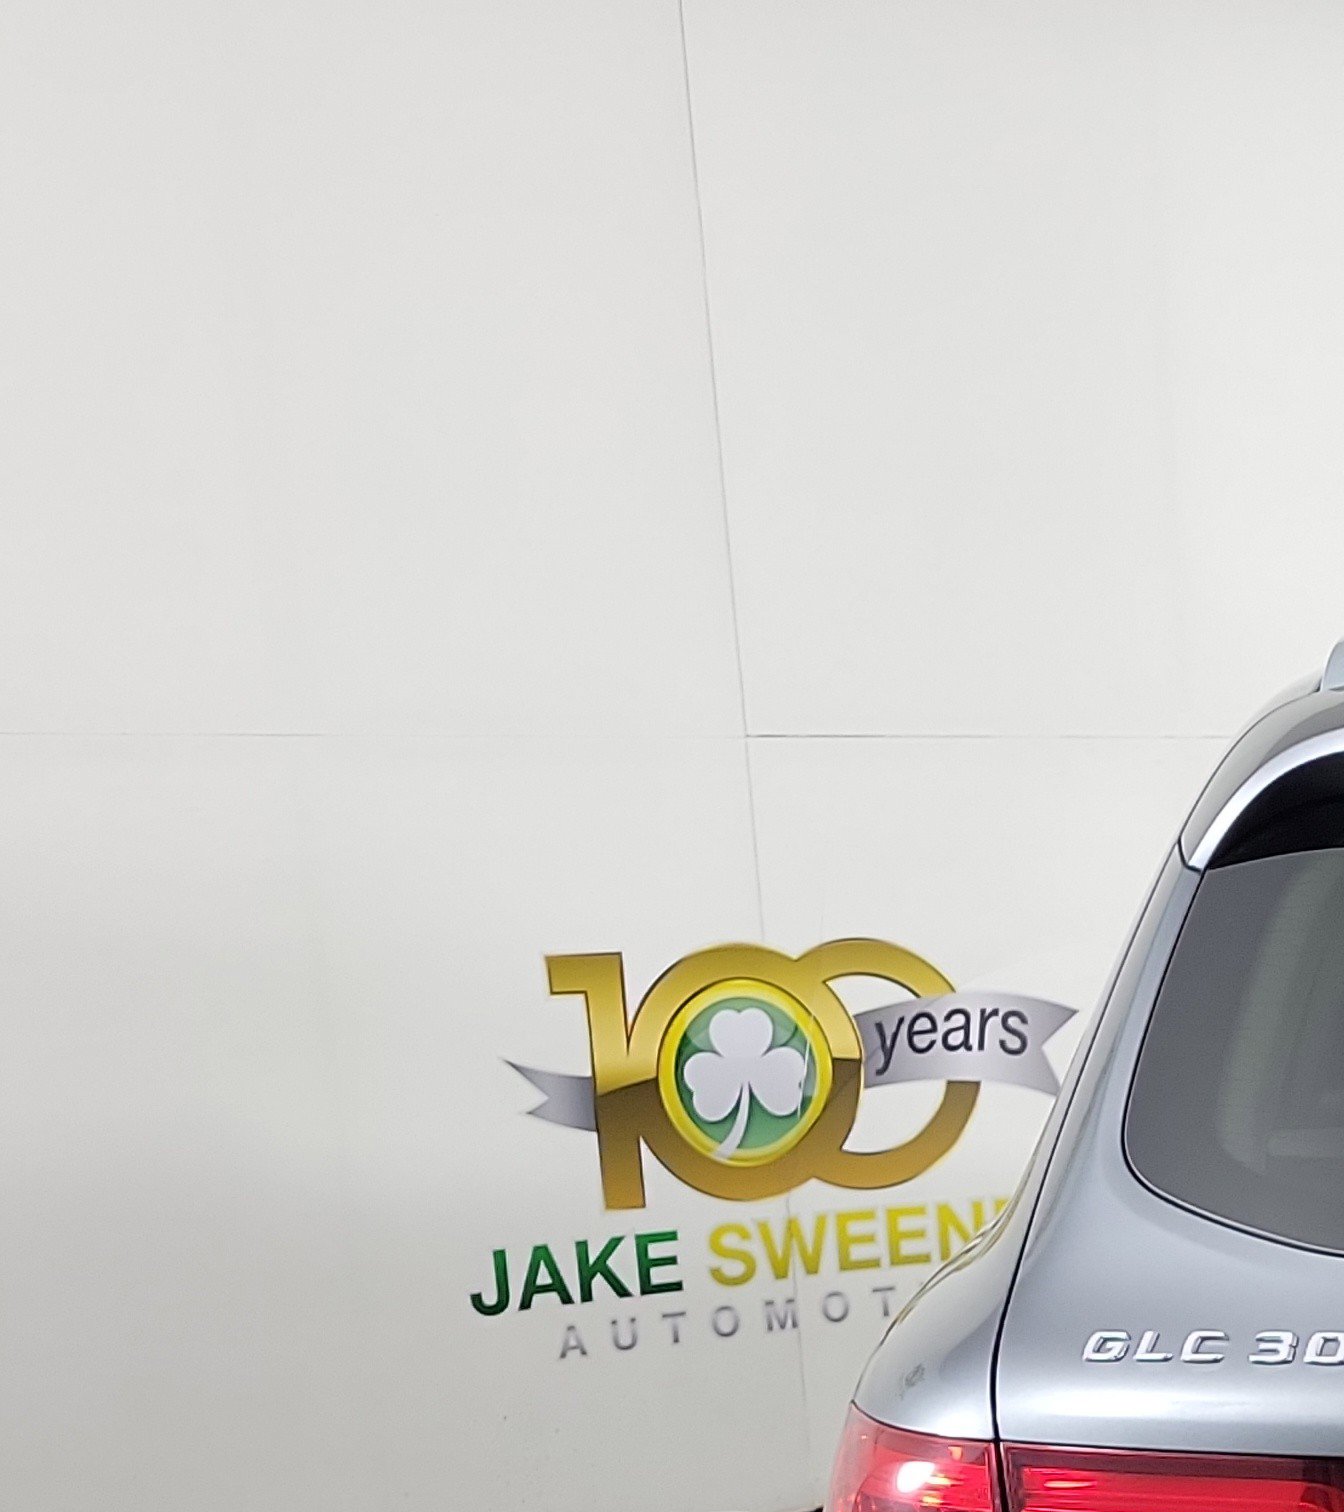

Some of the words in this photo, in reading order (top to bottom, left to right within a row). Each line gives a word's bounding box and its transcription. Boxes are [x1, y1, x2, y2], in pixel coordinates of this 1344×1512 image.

[874, 1003, 1029, 1076] years
[469, 1229, 684, 1317] JAKE
[707, 1197, 1012, 1288] SWEEN
[558, 1286, 898, 1360] AUTOMOT
[1082, 1329, 1230, 1364] GLC
